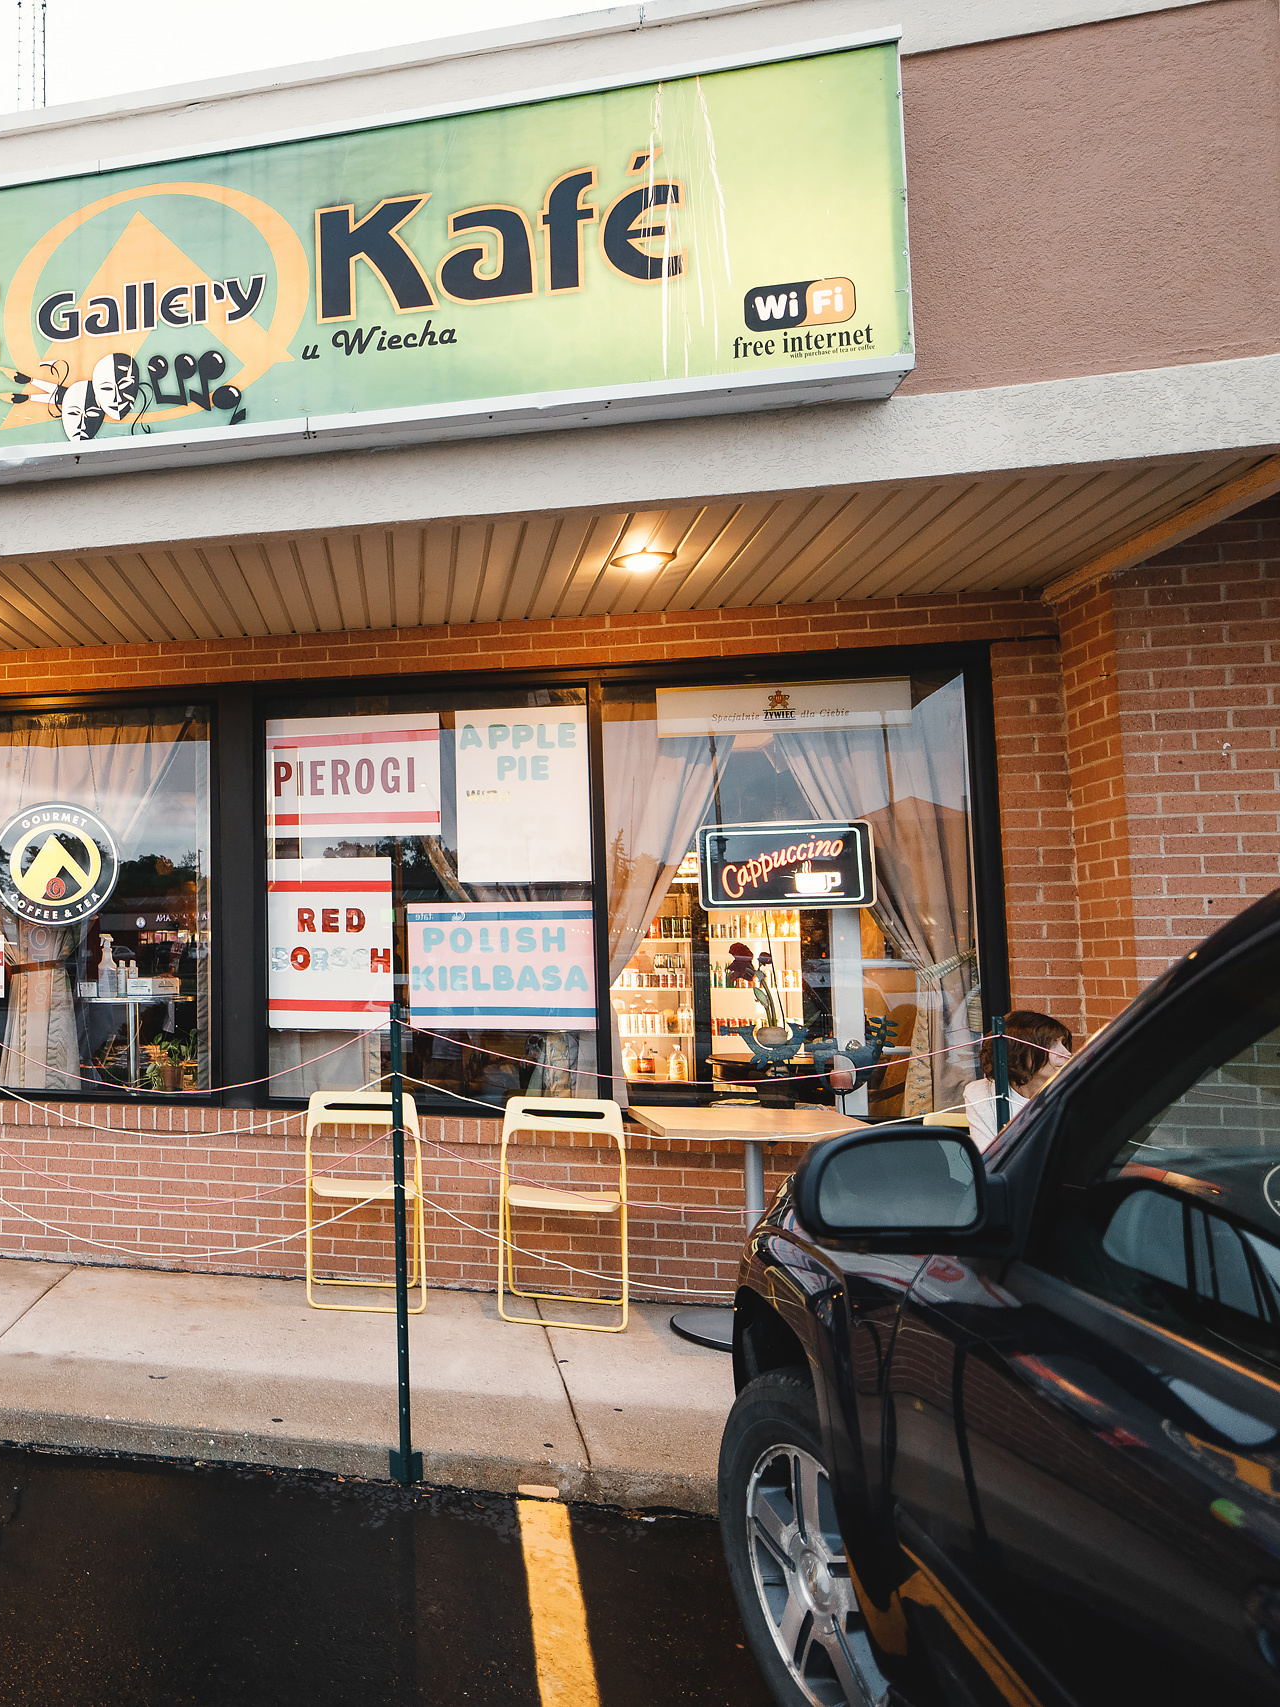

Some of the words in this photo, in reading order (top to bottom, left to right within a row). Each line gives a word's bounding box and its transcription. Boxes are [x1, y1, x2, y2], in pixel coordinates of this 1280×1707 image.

[315, 147, 691, 326] Kafé
[36, 272, 267, 342] Gallery
[301, 341, 320, 362] u
[331, 319, 458, 358] Wiecha
[732, 336, 775, 359] free
[782, 323, 873, 354] internet
[790, 351, 803, 359] with
[804, 348, 831, 359] purchase
[840, 346, 849, 354] tea
[858, 343, 876, 351] coffee
[711, 712, 760, 724] Specjalnie
[800, 710, 815, 718] dla
[819, 708, 850, 718] Ciebie
[459, 722, 577, 751] APPLE
[273, 756, 416, 798] PIEROGI
[496, 755, 550, 782] PIE
[21, 812, 88, 829] GOURMET
[721, 834, 844, 899] Cappuccino
[10, 893, 58, 920] COFFEE
[64, 908, 73, 918] &
[75, 892, 101, 913] TEA
[297, 907, 367, 934] RED
[422, 926, 566, 954] POLISH
[411, 965, 589, 992] KIELBASA
